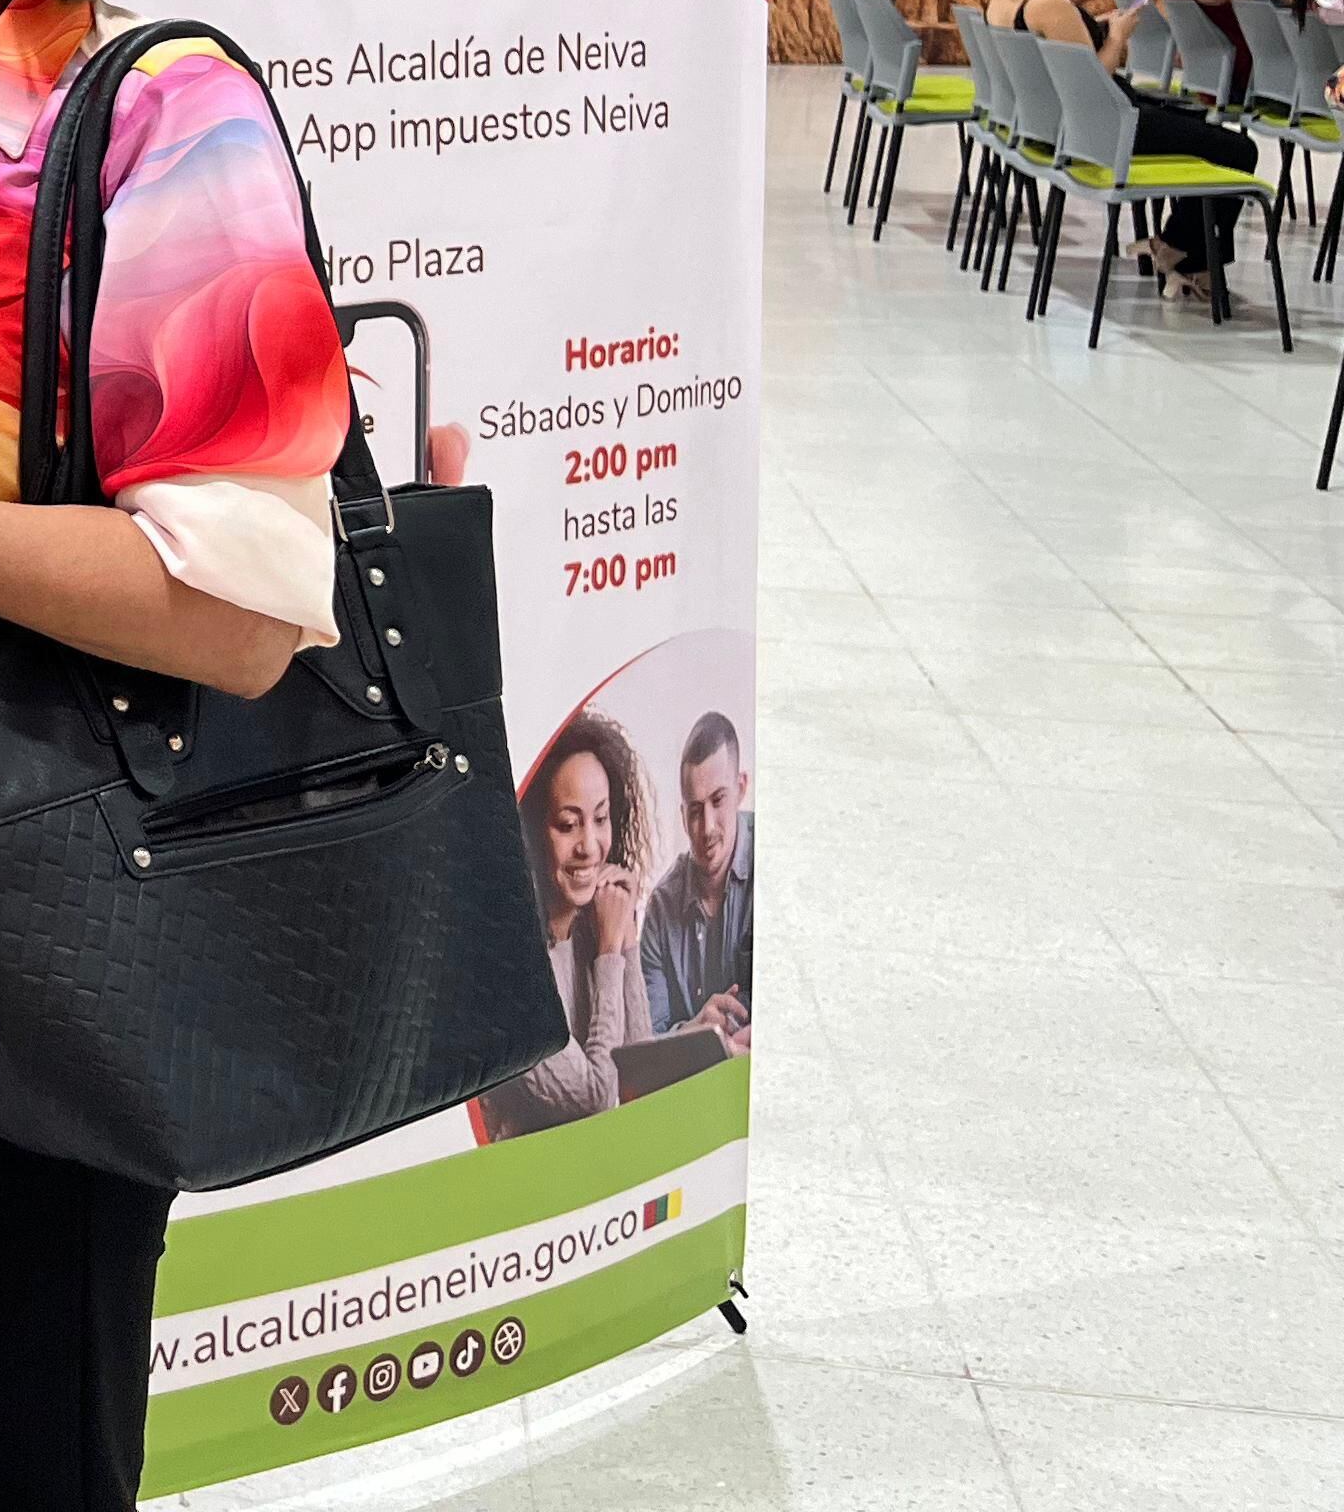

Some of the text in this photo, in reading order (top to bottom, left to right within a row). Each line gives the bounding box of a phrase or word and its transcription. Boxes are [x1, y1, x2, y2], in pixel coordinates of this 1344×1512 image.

[346, 35, 491, 86] Alcaldía
[504, 35, 545, 76] de
[558, 31, 646, 73] Neiva
[296, 92, 669, 163] App impuestos Neiva
[388, 237, 484, 281] Plaza
[565, 326, 679, 373] Horario:
[479, 374, 742, 440] Sábados y Domingo
[565, 443, 677, 485] 2:00 pm
[564, 493, 677, 542] hasta las
[563, 552, 676, 597] 7:00 pm
[149, 1207, 638, 1375] w.alcaldiadeneiva.gov.co
